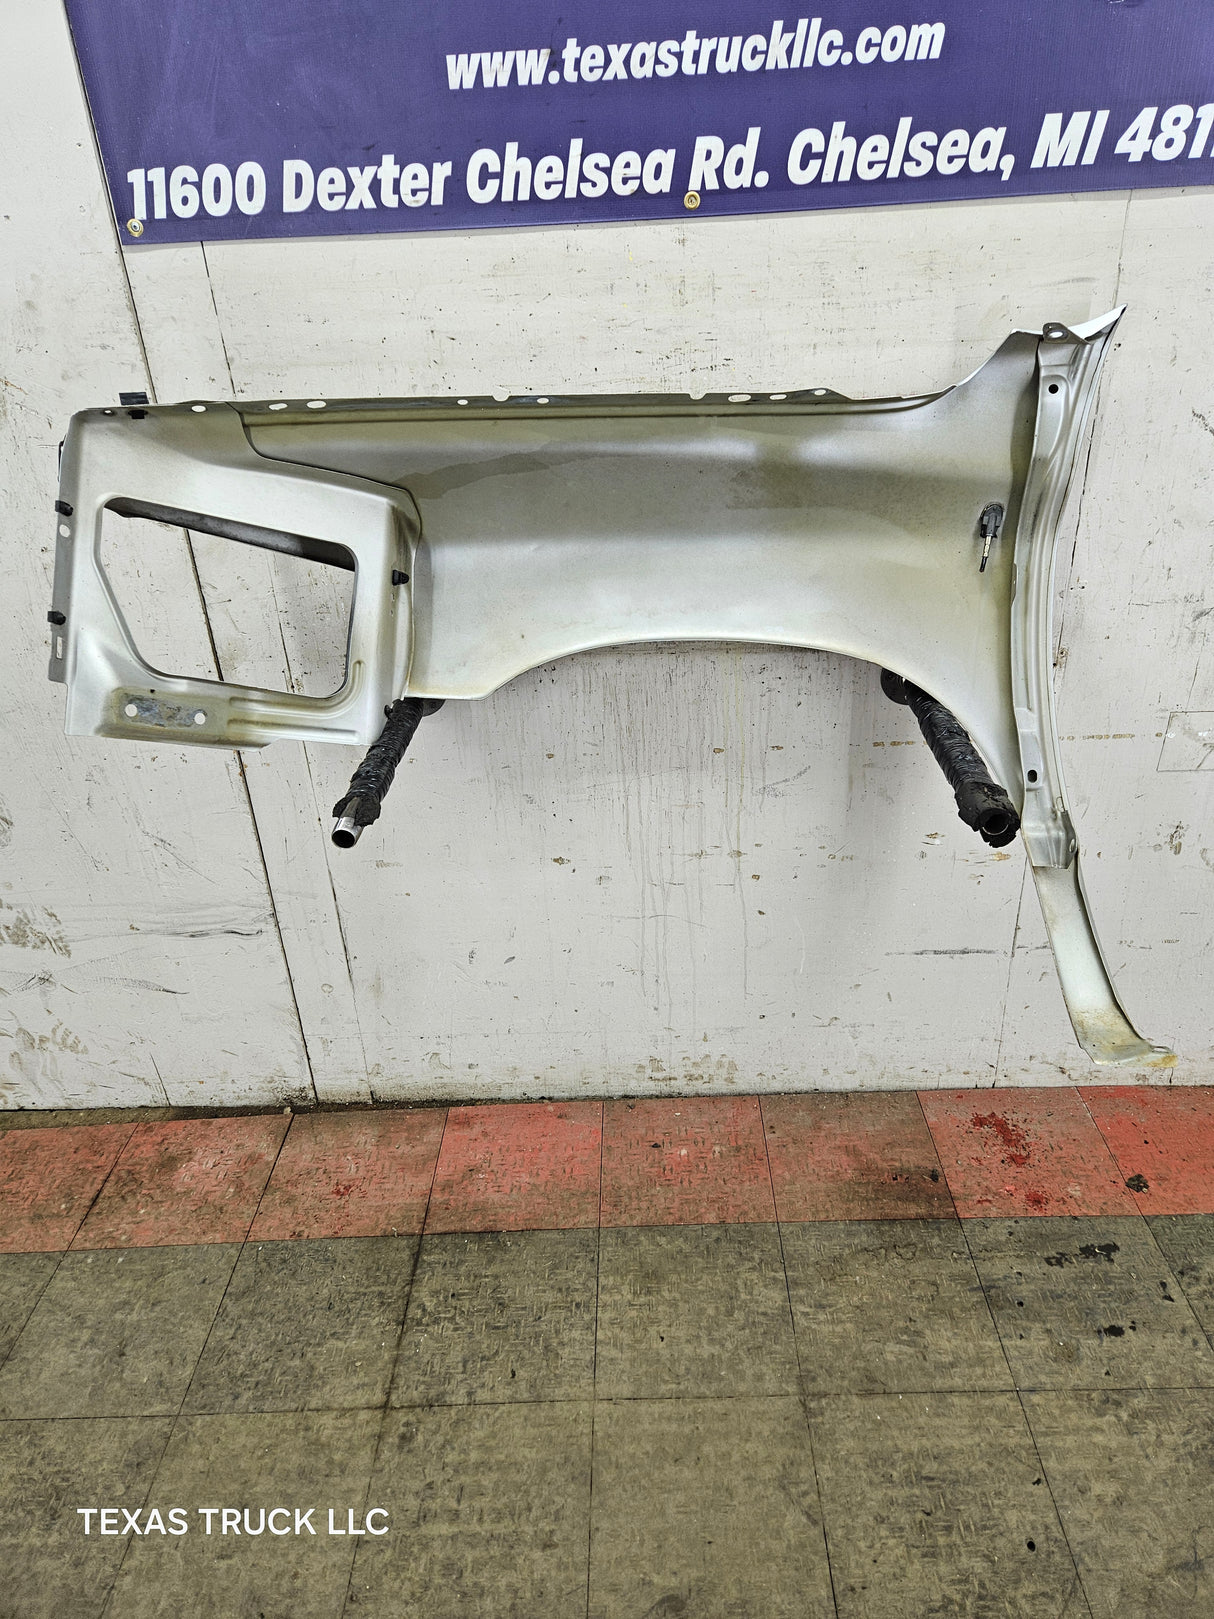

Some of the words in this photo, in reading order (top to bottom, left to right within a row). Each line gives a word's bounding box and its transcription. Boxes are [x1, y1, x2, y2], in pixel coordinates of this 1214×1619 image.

[446, 18, 945, 91] www.texastruckllc.com
[126, 161, 267, 221] 11600
[282, 154, 453, 213] Dexter
[466, 138, 677, 204] Chelsea
[687, 127, 770, 192] Rd.
[787, 117, 1015, 182] Chelsea,
[1030, 109, 1111, 169] MI
[1114, 102, 1214, 163] 481
